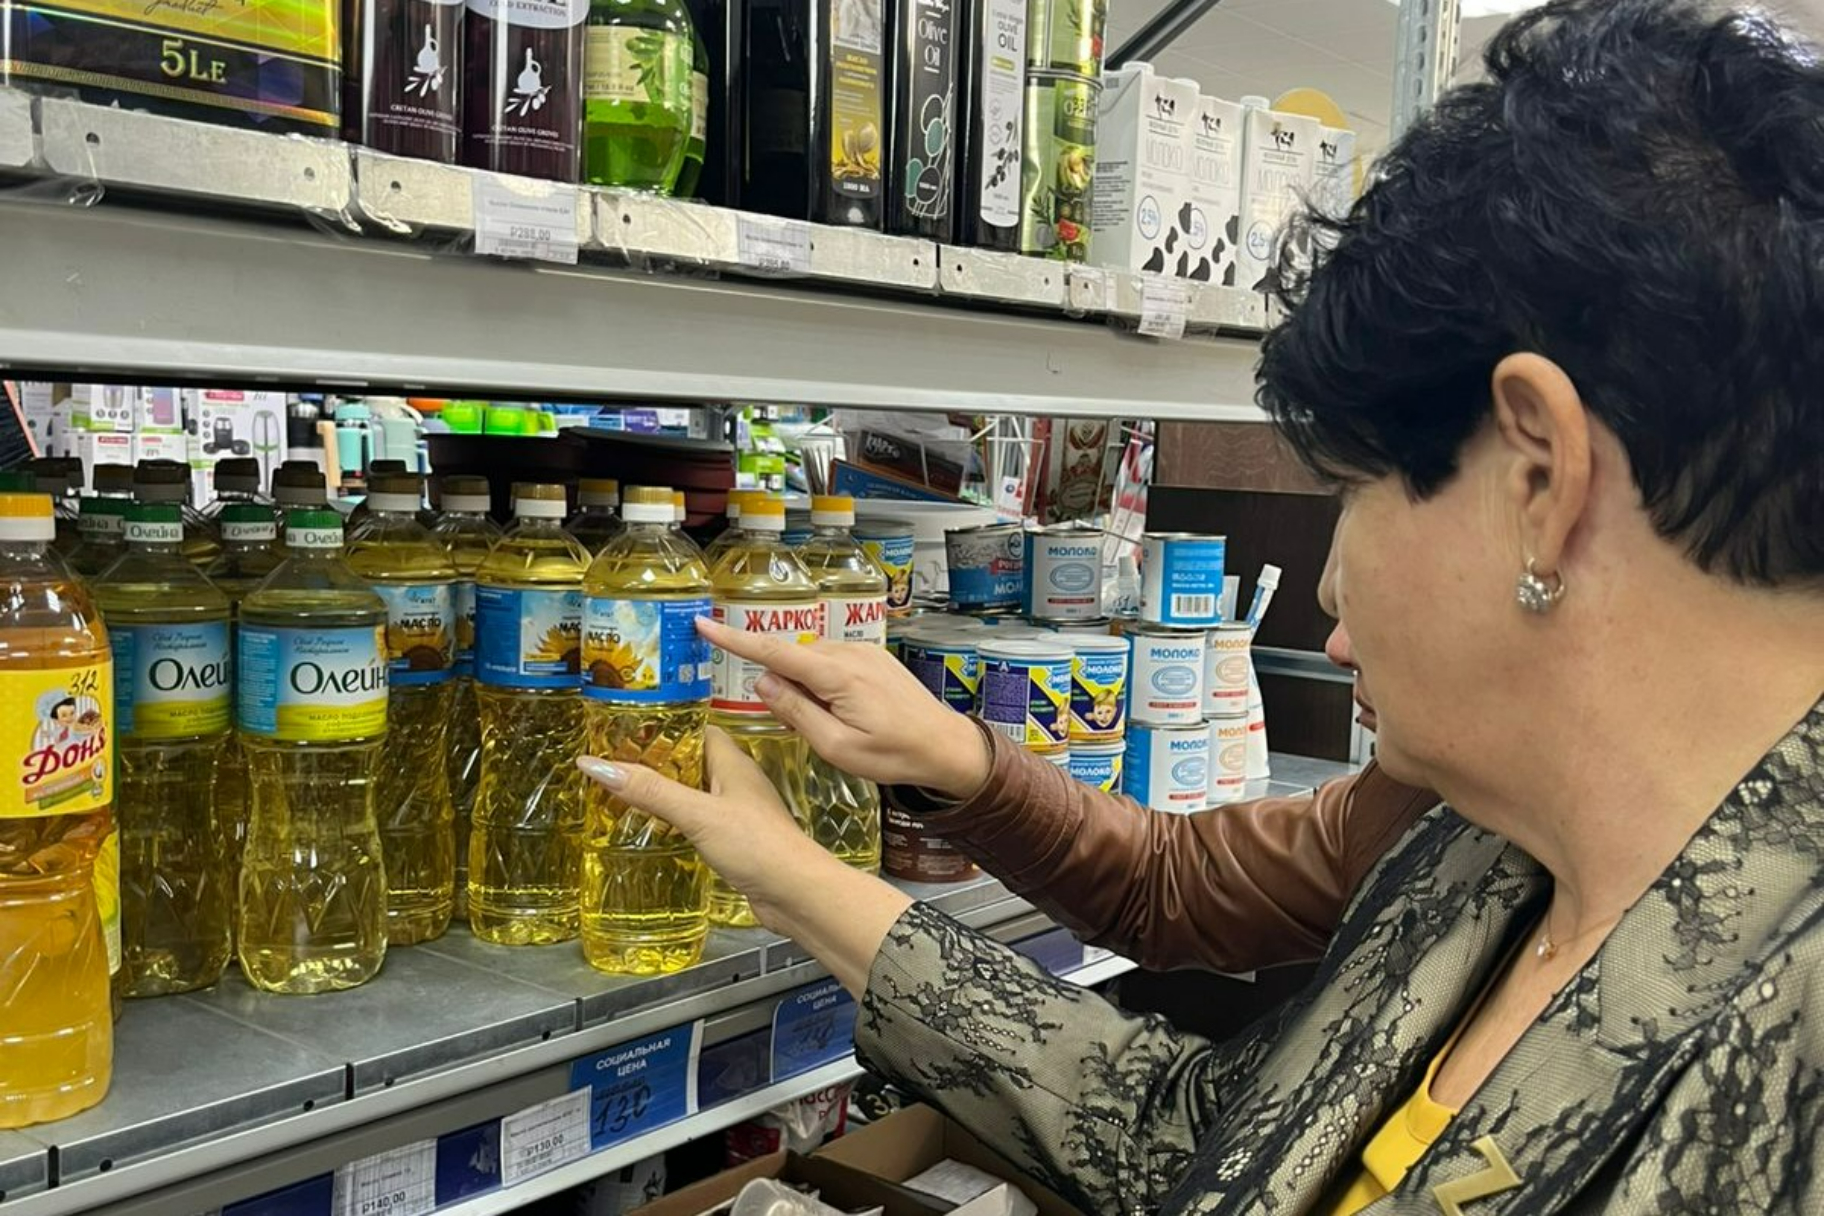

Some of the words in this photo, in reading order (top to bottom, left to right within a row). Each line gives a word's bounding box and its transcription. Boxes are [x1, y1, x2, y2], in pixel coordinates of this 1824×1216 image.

[998, 33, 1017, 52] OIL
[559, 622, 582, 632] МАС
[1151, 648, 1200, 659] МОЛОКО
[290, 658, 388, 695] Олейн
[596, 1037, 671, 1070] СОЦИАЛЬНАЯ
[617, 1059, 647, 1077] ЦЕНА
